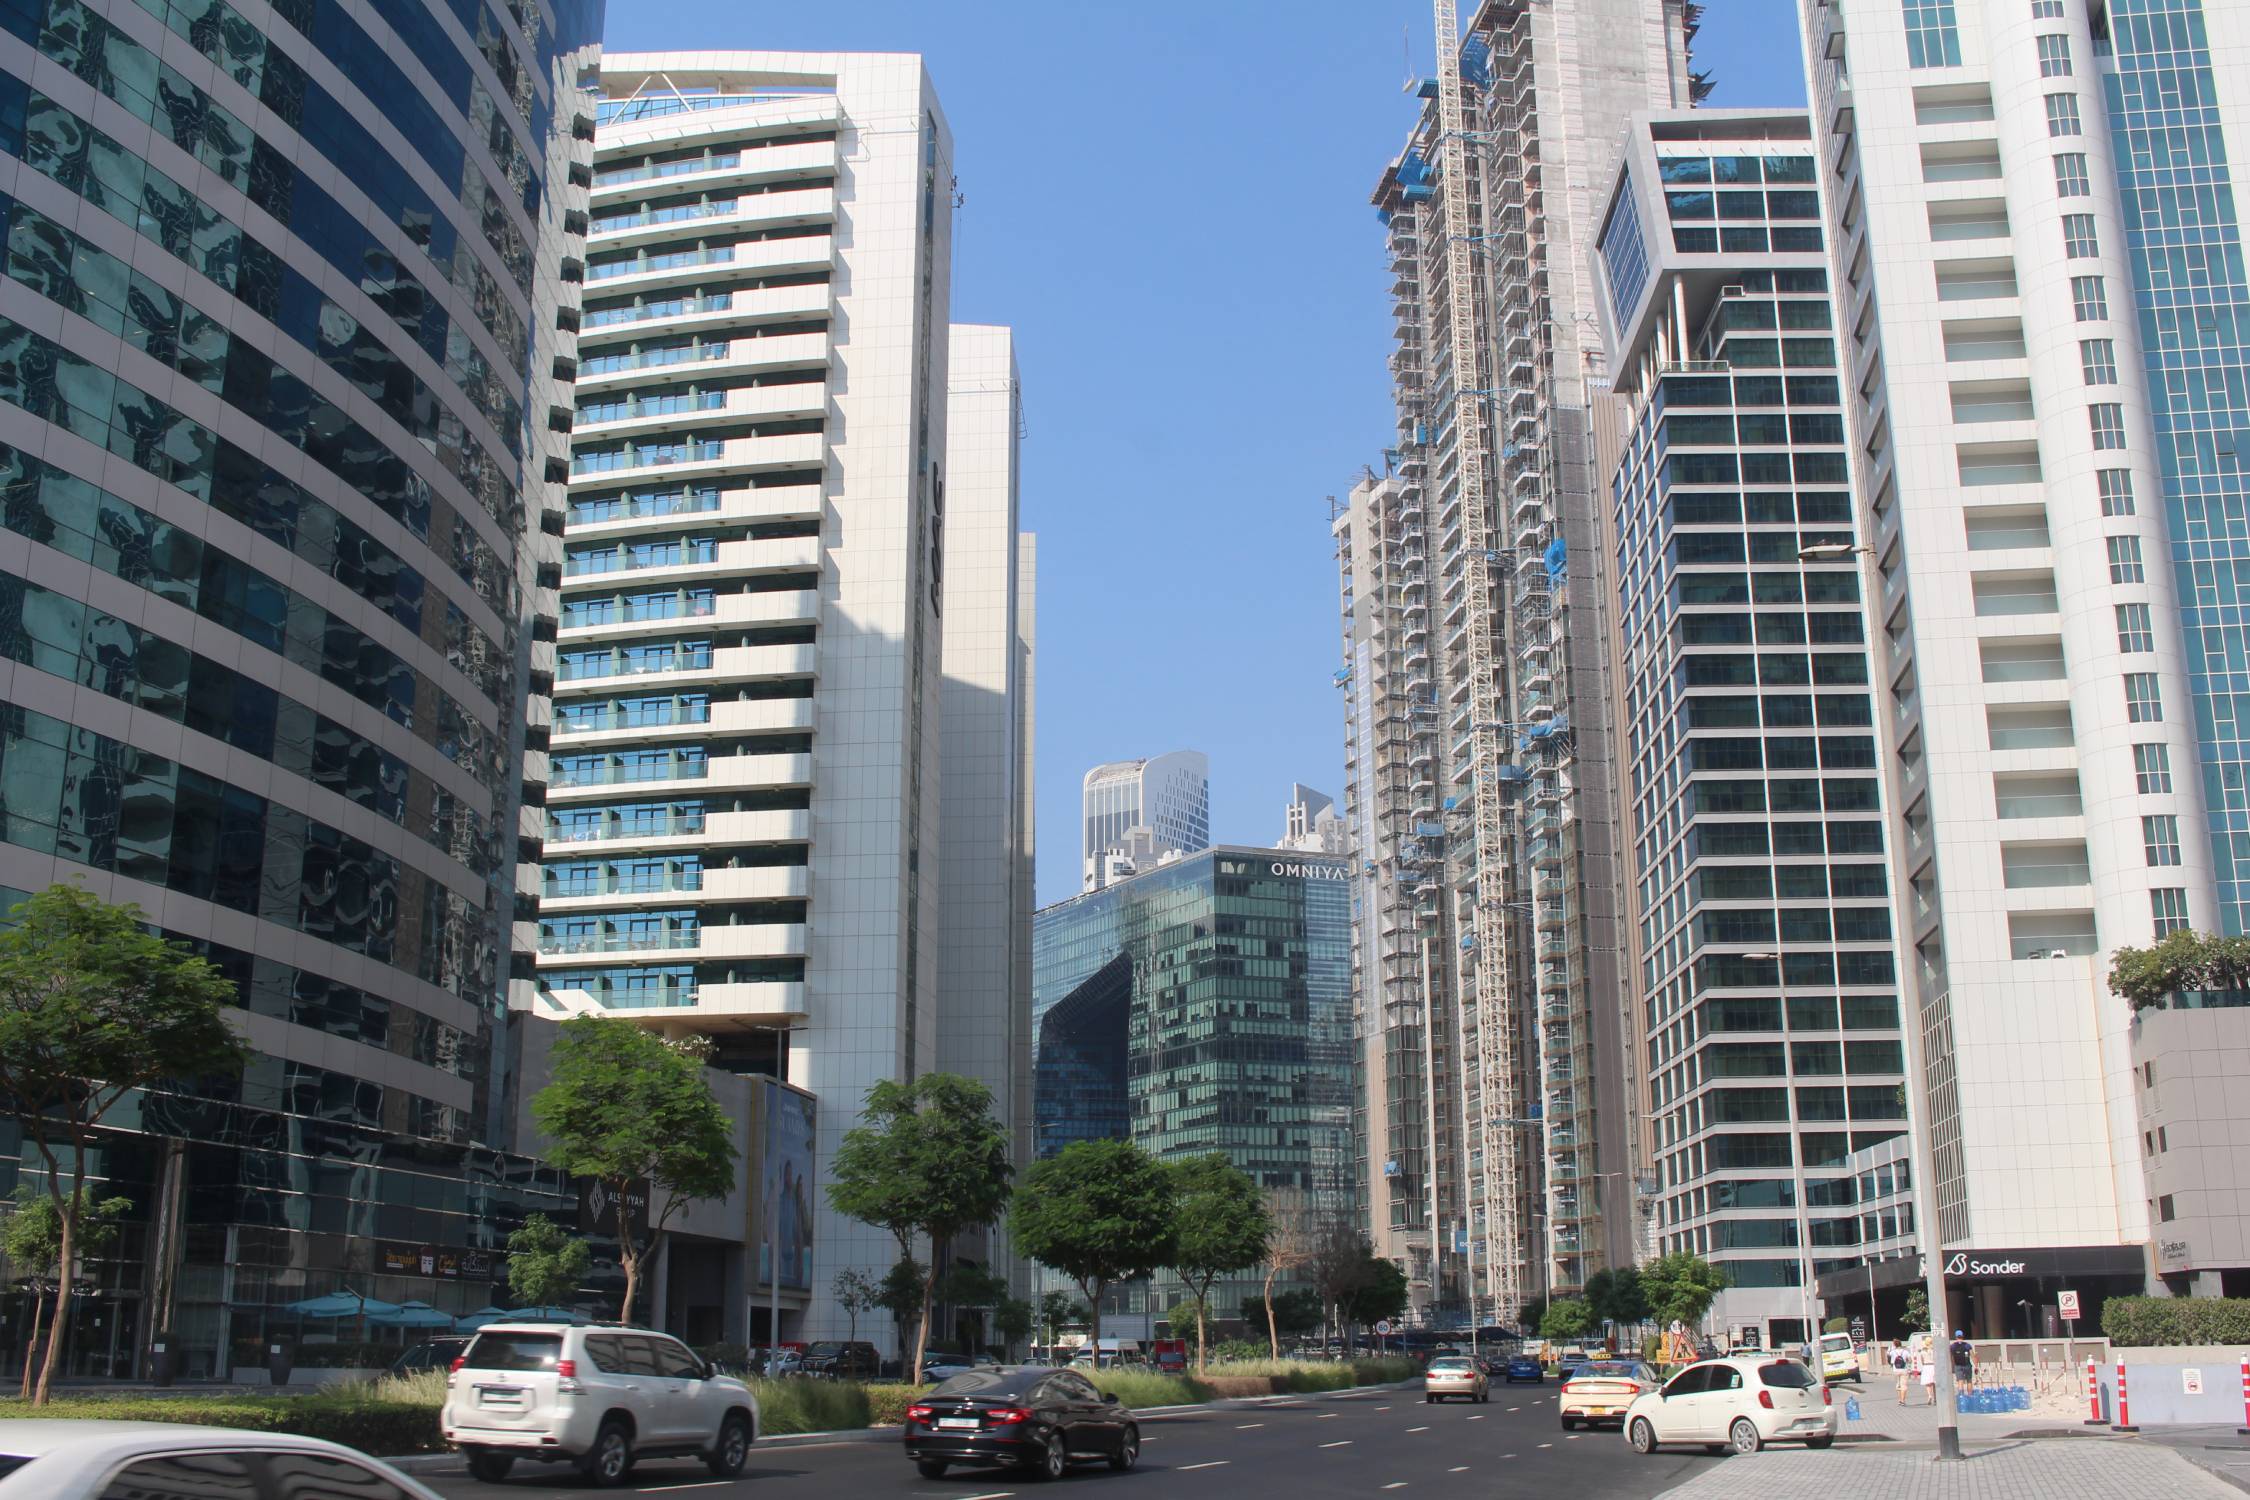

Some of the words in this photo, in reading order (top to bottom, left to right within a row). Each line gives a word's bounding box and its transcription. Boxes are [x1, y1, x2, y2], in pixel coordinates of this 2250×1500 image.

[1271, 862, 1349, 880] OMNIYA
[608, 1191, 645, 1208] ALSYYAH
[1970, 1260, 2025, 1274] Sonder
